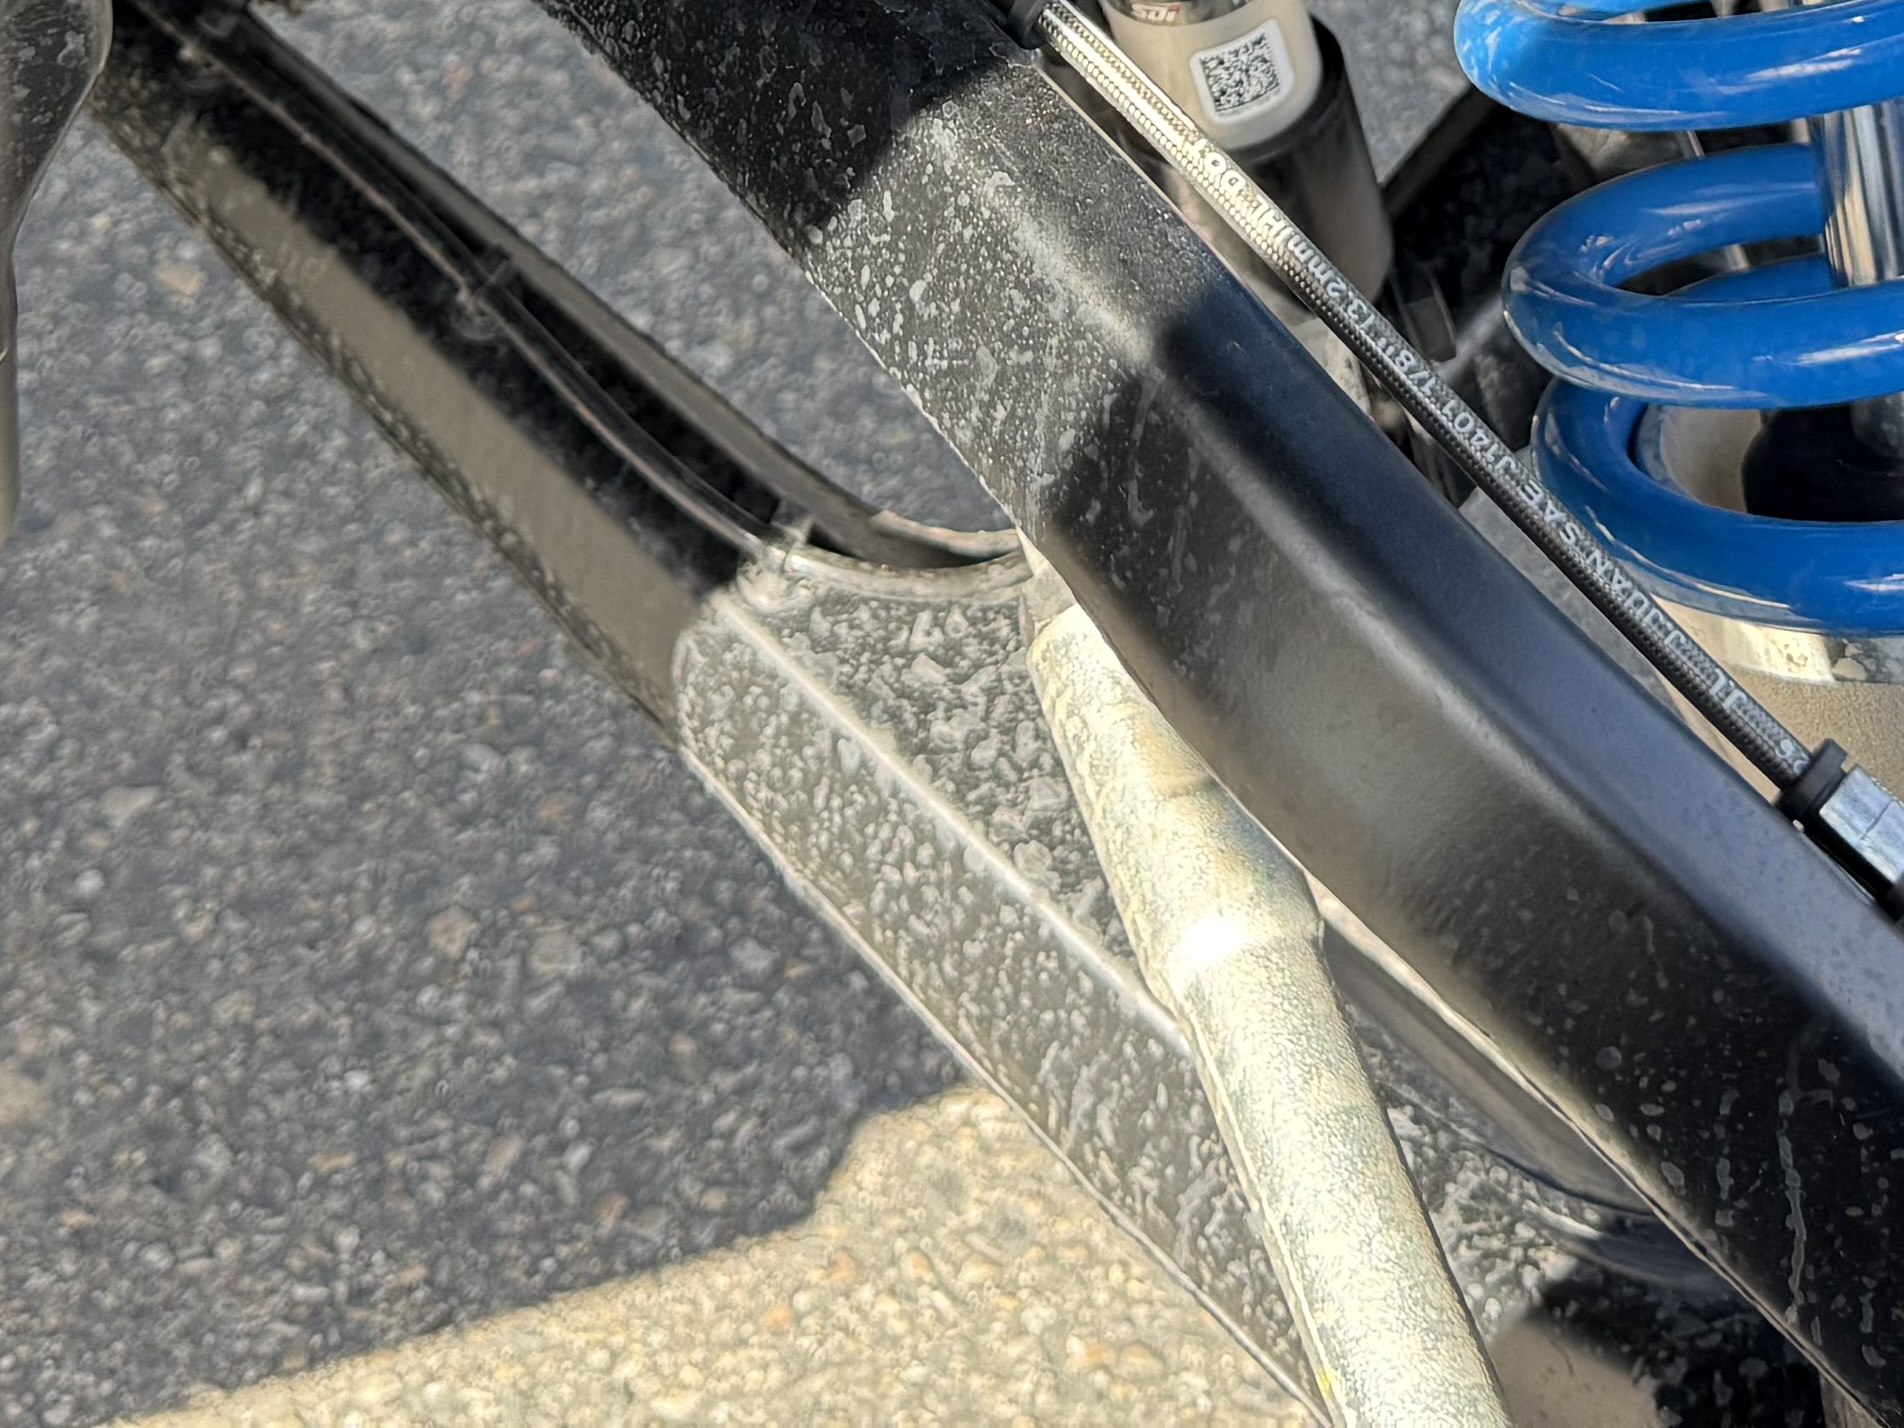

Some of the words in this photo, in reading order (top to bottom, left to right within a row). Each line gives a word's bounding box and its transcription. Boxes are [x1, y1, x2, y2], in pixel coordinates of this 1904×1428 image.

[1181, 131, 1248, 199] DOT
[1437, 396, 1519, 478] J1401
[1517, 477, 1585, 545] SAE
[1581, 546, 1689, 653] J.JUAN
